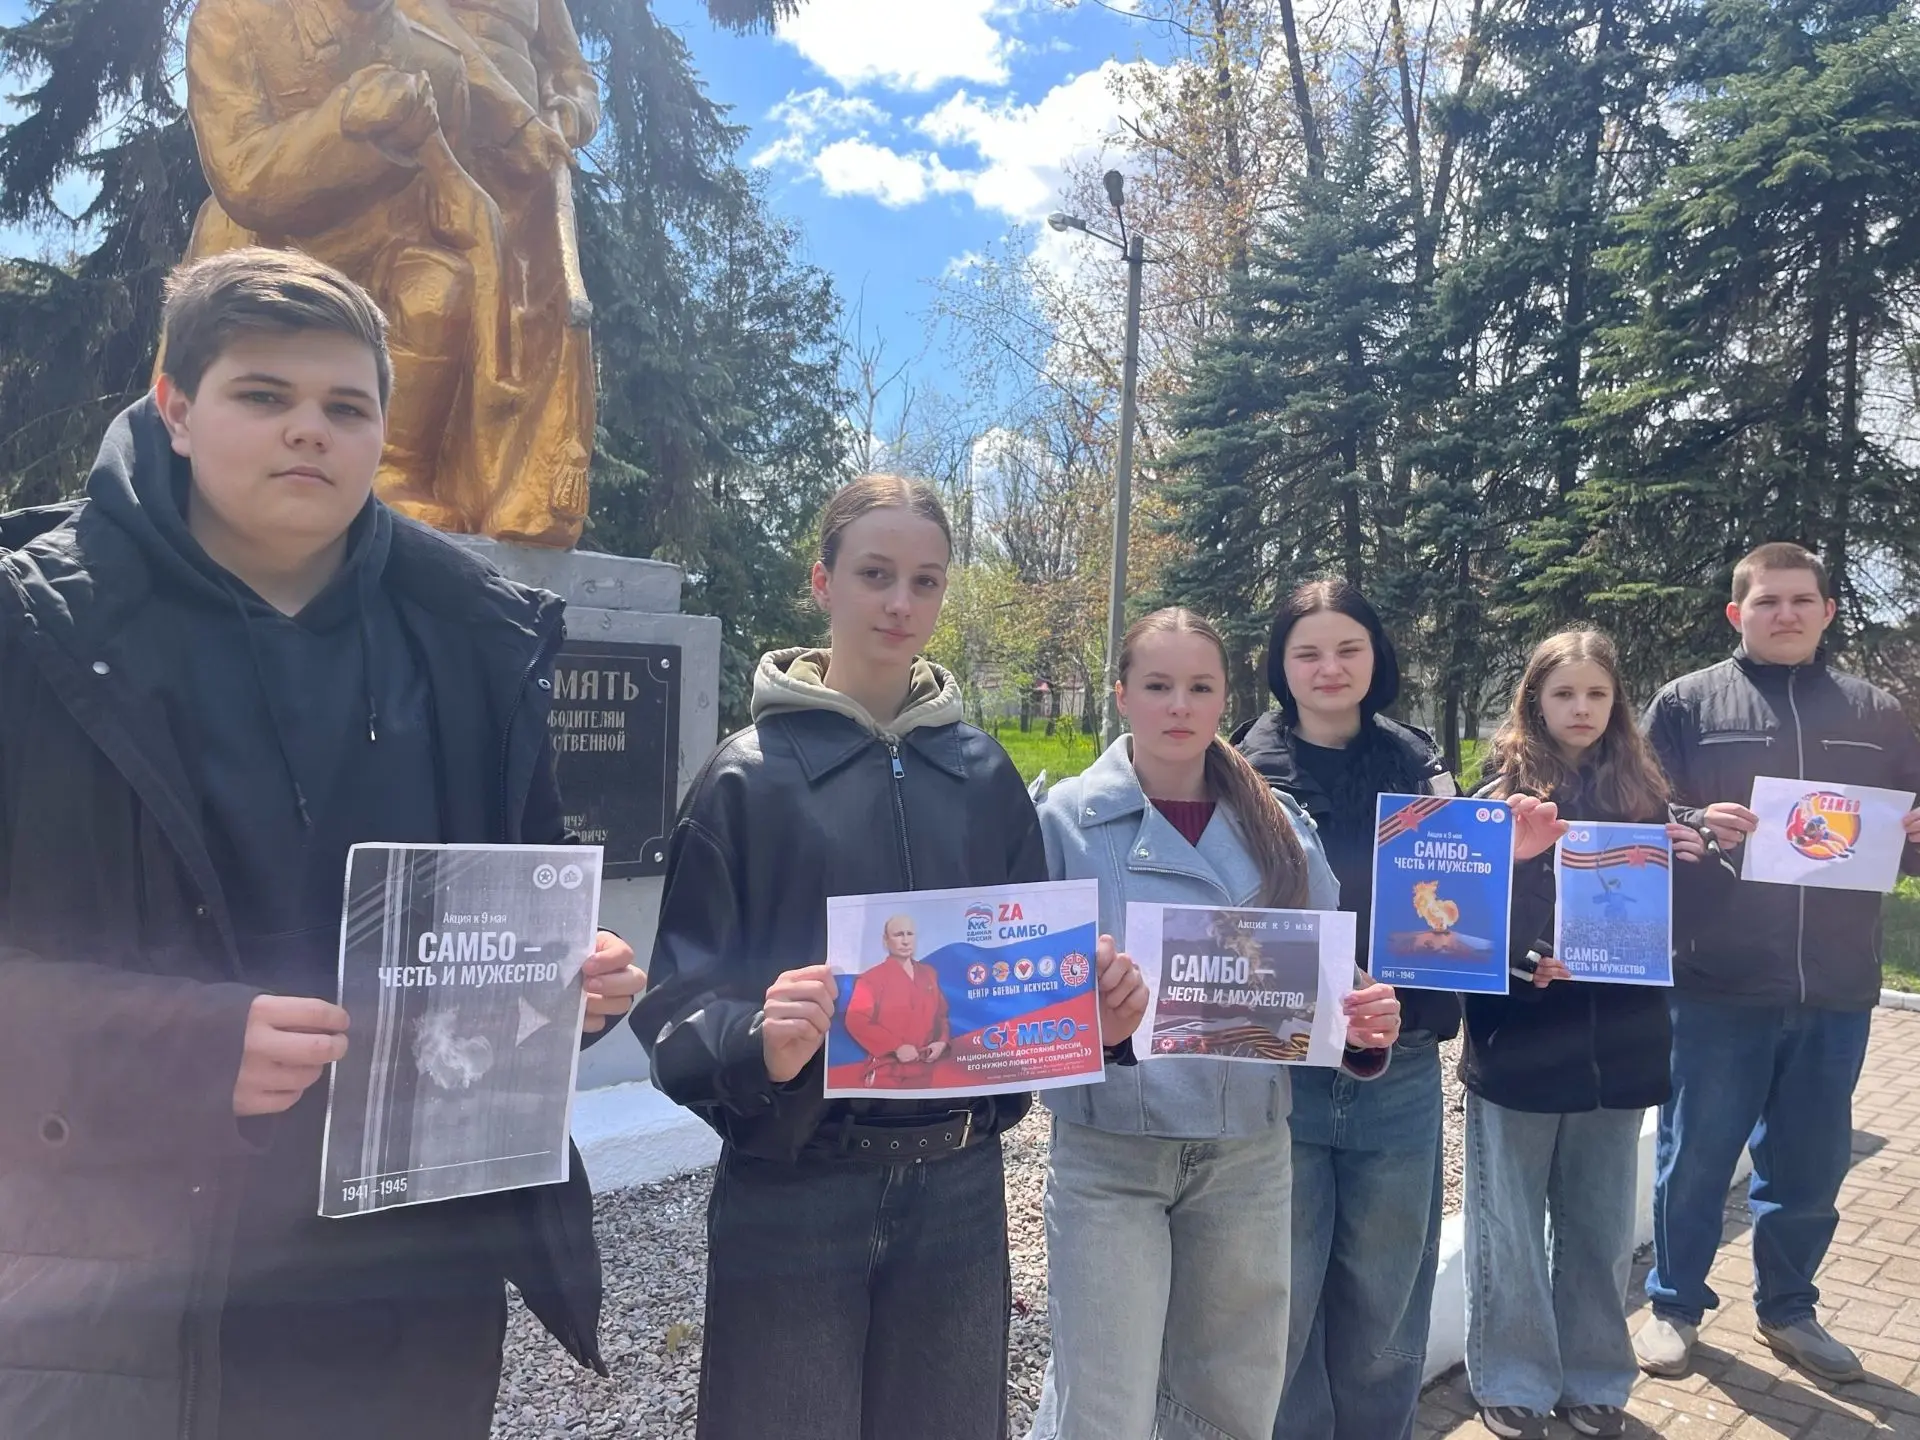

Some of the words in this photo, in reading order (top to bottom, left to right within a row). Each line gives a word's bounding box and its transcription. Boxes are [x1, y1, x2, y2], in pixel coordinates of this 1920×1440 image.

[547, 710, 625, 728] БОДИТЕЛЯМ
[1819, 797, 1861, 813] САМБО
[1414, 840, 1468, 860] САМБО
[1394, 857, 1425, 870] ЧЕСТЬ
[1427, 859, 1435, 871] И
[1437, 860, 1492, 874] МУЖЕСТВО
[443, 911, 472, 925] Акция
[473, 915, 480, 924] к
[481, 911, 488, 923] 9
[490, 914, 507, 924] мая
[998, 903, 1024, 922] ZA
[966, 929, 992, 937] ЕДИНАЯ
[998, 923, 1048, 940] САМБО
[1237, 920, 1268, 931] Акция
[1272, 922, 1279, 930] к
[1283, 921, 1291, 930] 9
[1295, 923, 1314, 931] мая
[418, 931, 517, 963] САМБО
[966, 935, 992, 943] РОССИЯ
[1565, 946, 1609, 963] САМБО
[378, 966, 438, 988] ЧЕСТЬ
[441, 965, 456, 986] И
[460, 963, 558, 988] МУЖЕСТВО
[1170, 954, 1250, 984] САМБО
[1565, 962, 1590, 972] ЧЕСТЬ
[1592, 963, 1598, 972] И
[1600, 963, 1646, 976] МУЖЕСТВО
[967, 987, 990, 1000] ЦЕНТР
[992, 984, 1020, 997] БОЕВЫХ
[1167, 986, 1208, 1003] ЧЕСТЬ
[1212, 988, 1224, 1004] И
[1228, 990, 1304, 1008] МУЖЕСТВО
[956, 1050, 1015, 1063] НАЦИОНАЛЬНОЕ
[1015, 1044, 1055, 1057] ДОСТОЯНИЕ
[967, 1063, 981, 1071] ЕГО
[981, 1060, 1008, 1070] НУЖНО
[1009, 1057, 1038, 1067] ЛЮБИТЬ
